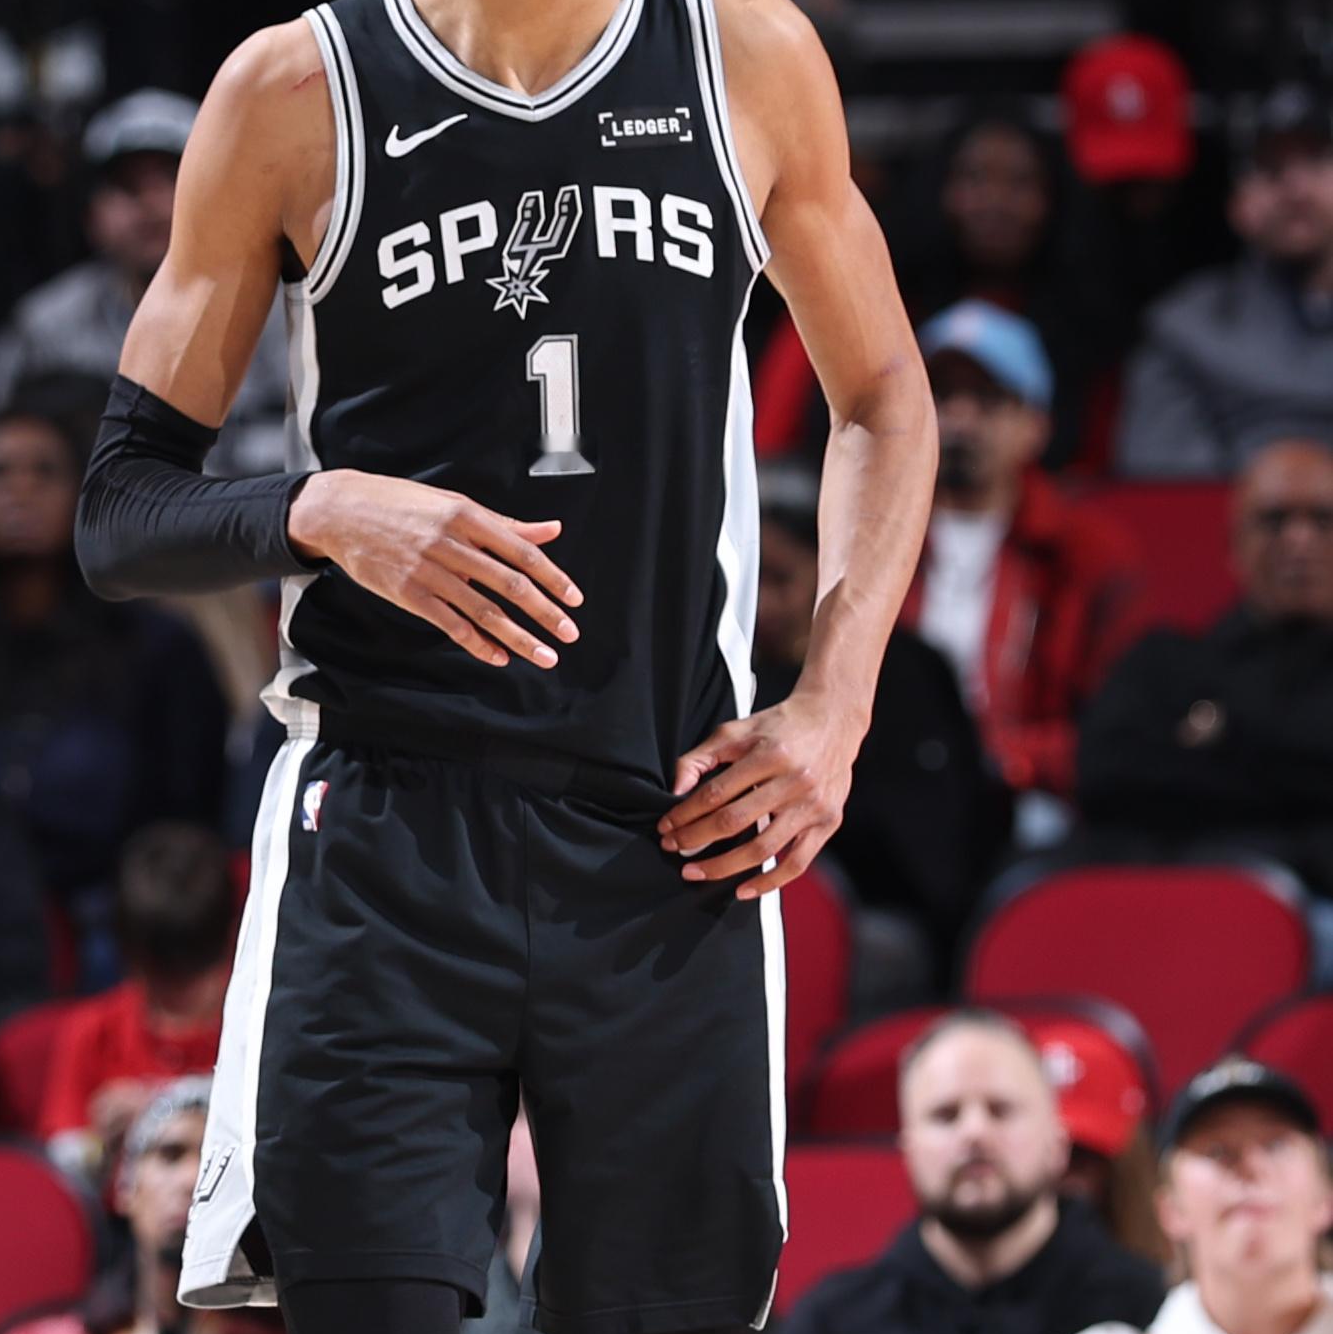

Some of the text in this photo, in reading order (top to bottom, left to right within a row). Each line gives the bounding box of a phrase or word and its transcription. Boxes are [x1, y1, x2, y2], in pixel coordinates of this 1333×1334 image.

[611, 117, 681, 137] LEDGER
[377, 184, 714, 319] SPURS
[526, 334, 595, 477] 1
